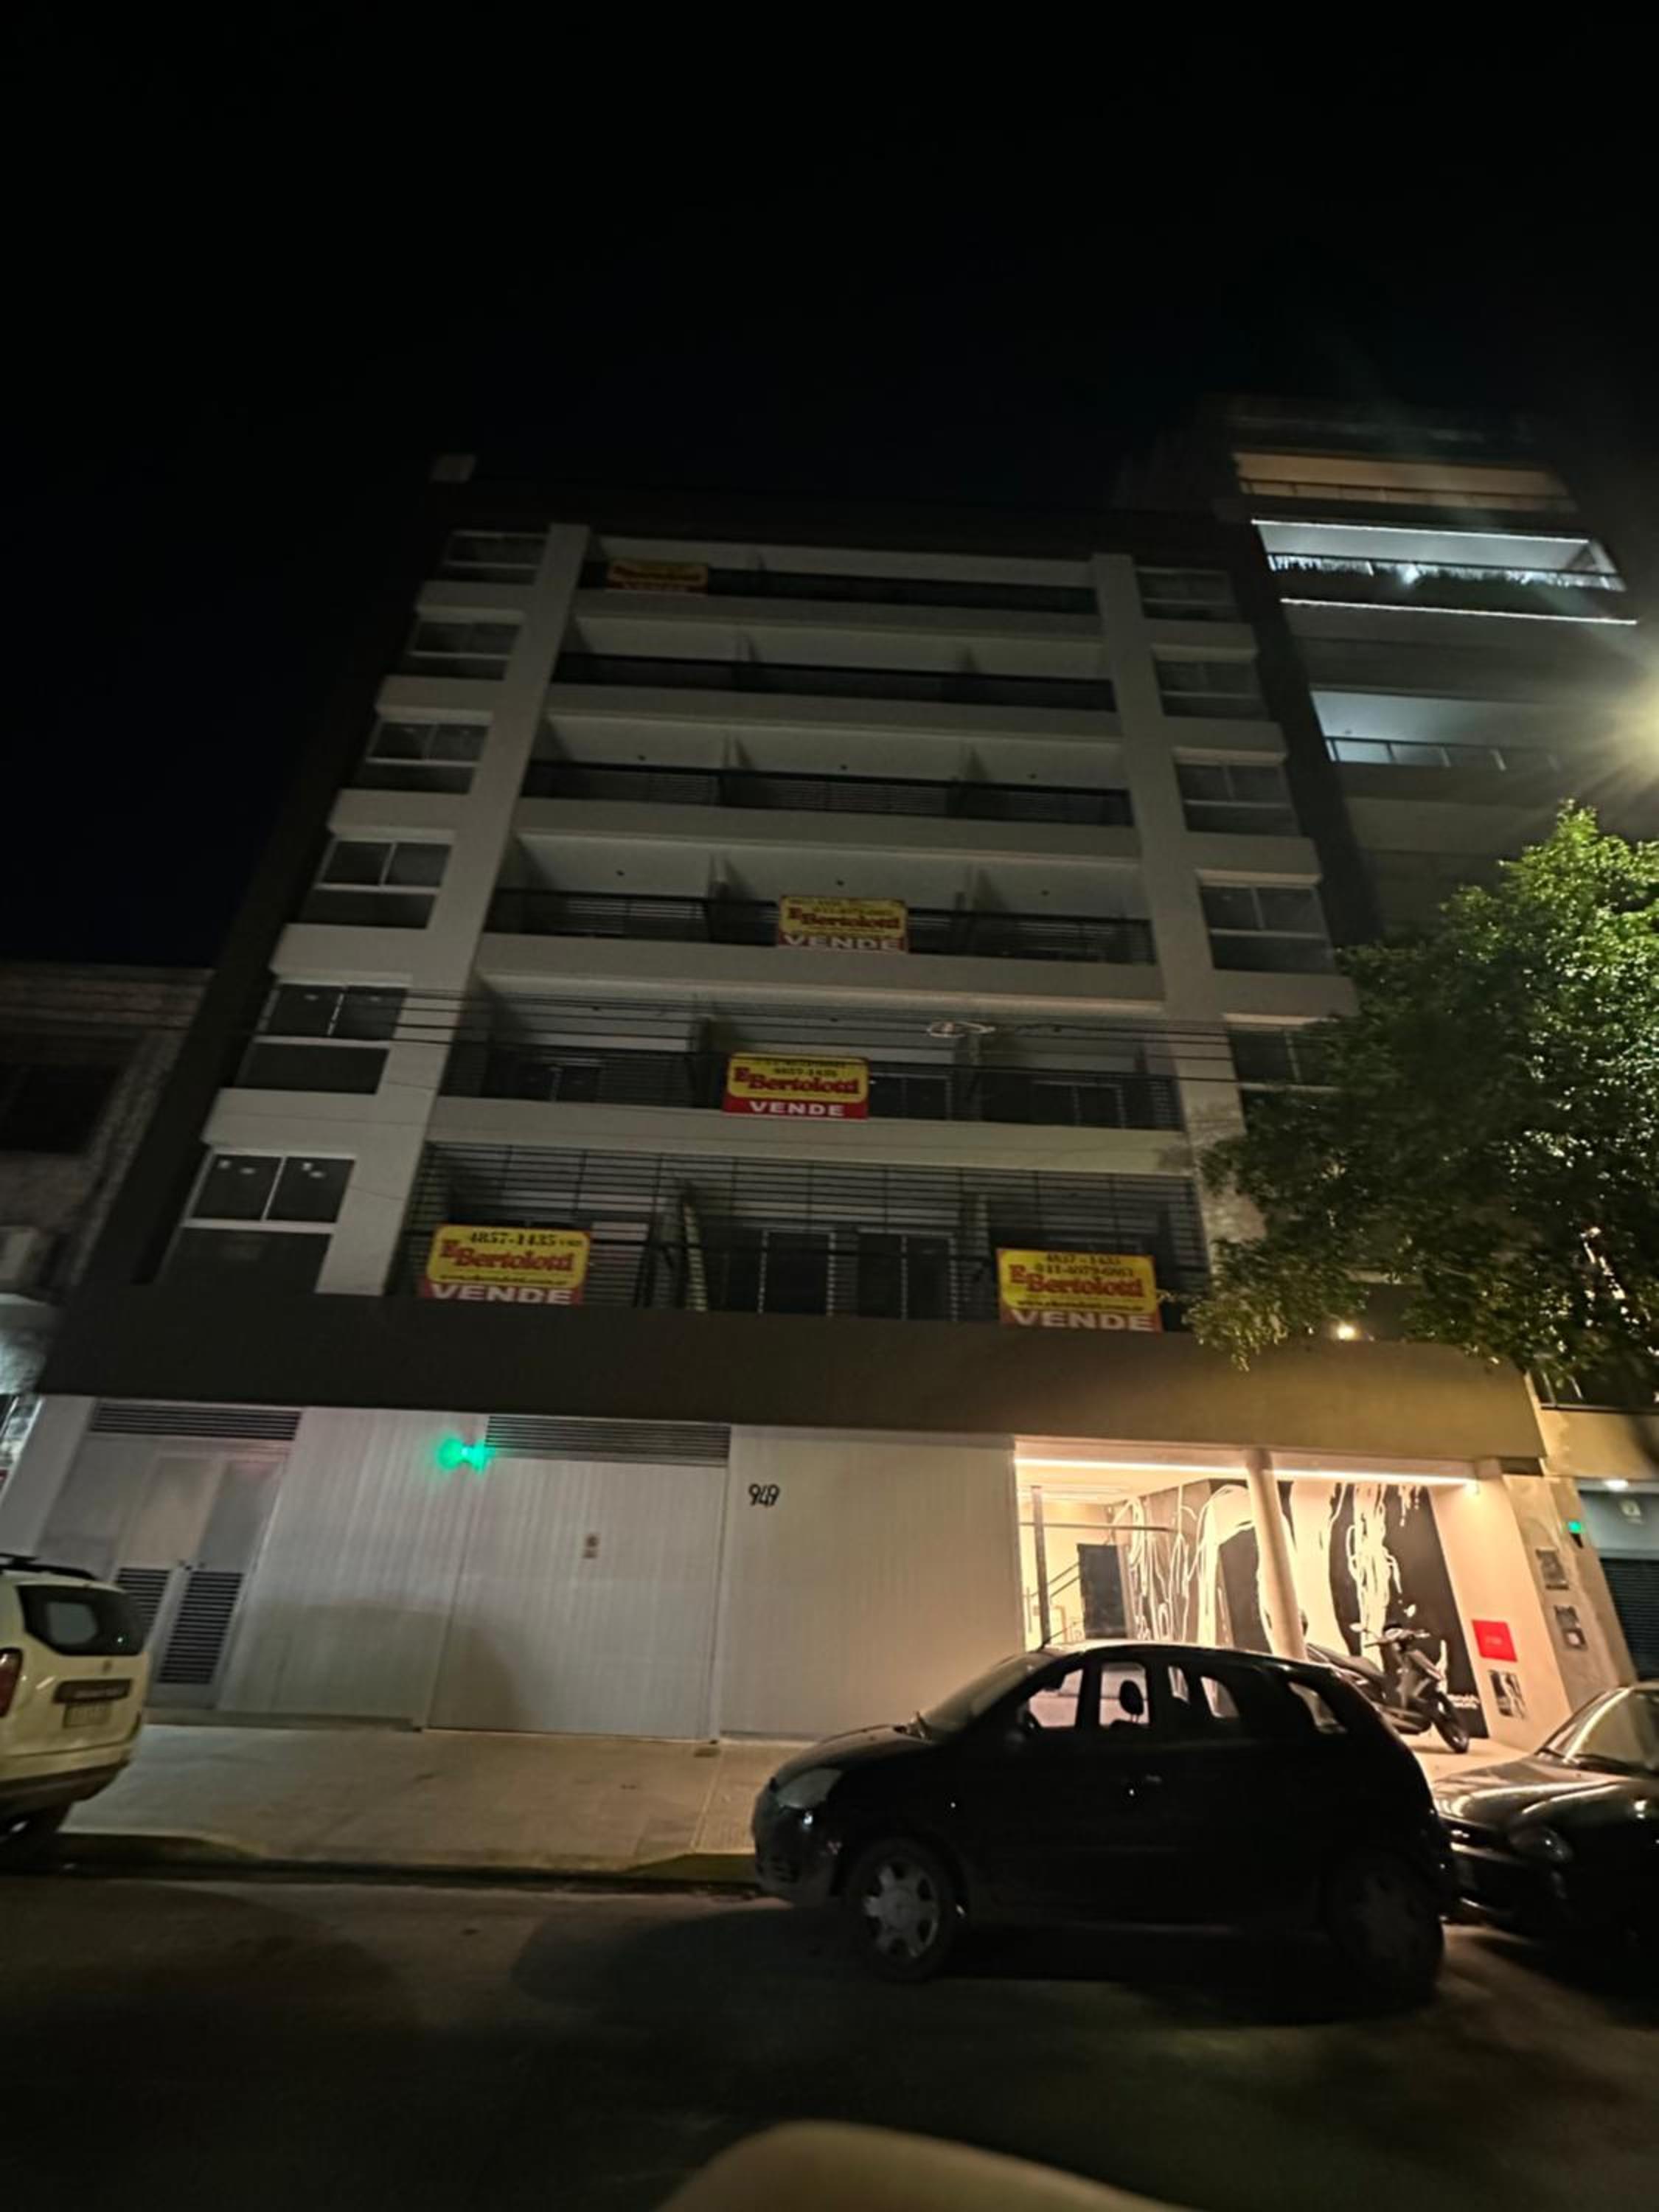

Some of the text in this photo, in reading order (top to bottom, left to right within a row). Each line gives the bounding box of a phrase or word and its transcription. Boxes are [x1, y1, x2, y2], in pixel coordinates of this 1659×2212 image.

[783, 935, 902, 950] VENDE
[749, 1101, 844, 1117] VENDE
[430, 1284, 574, 1305] VENDE
[1011, 1310, 1155, 1332] VENDE
[748, 1484, 780, 1508] 949
